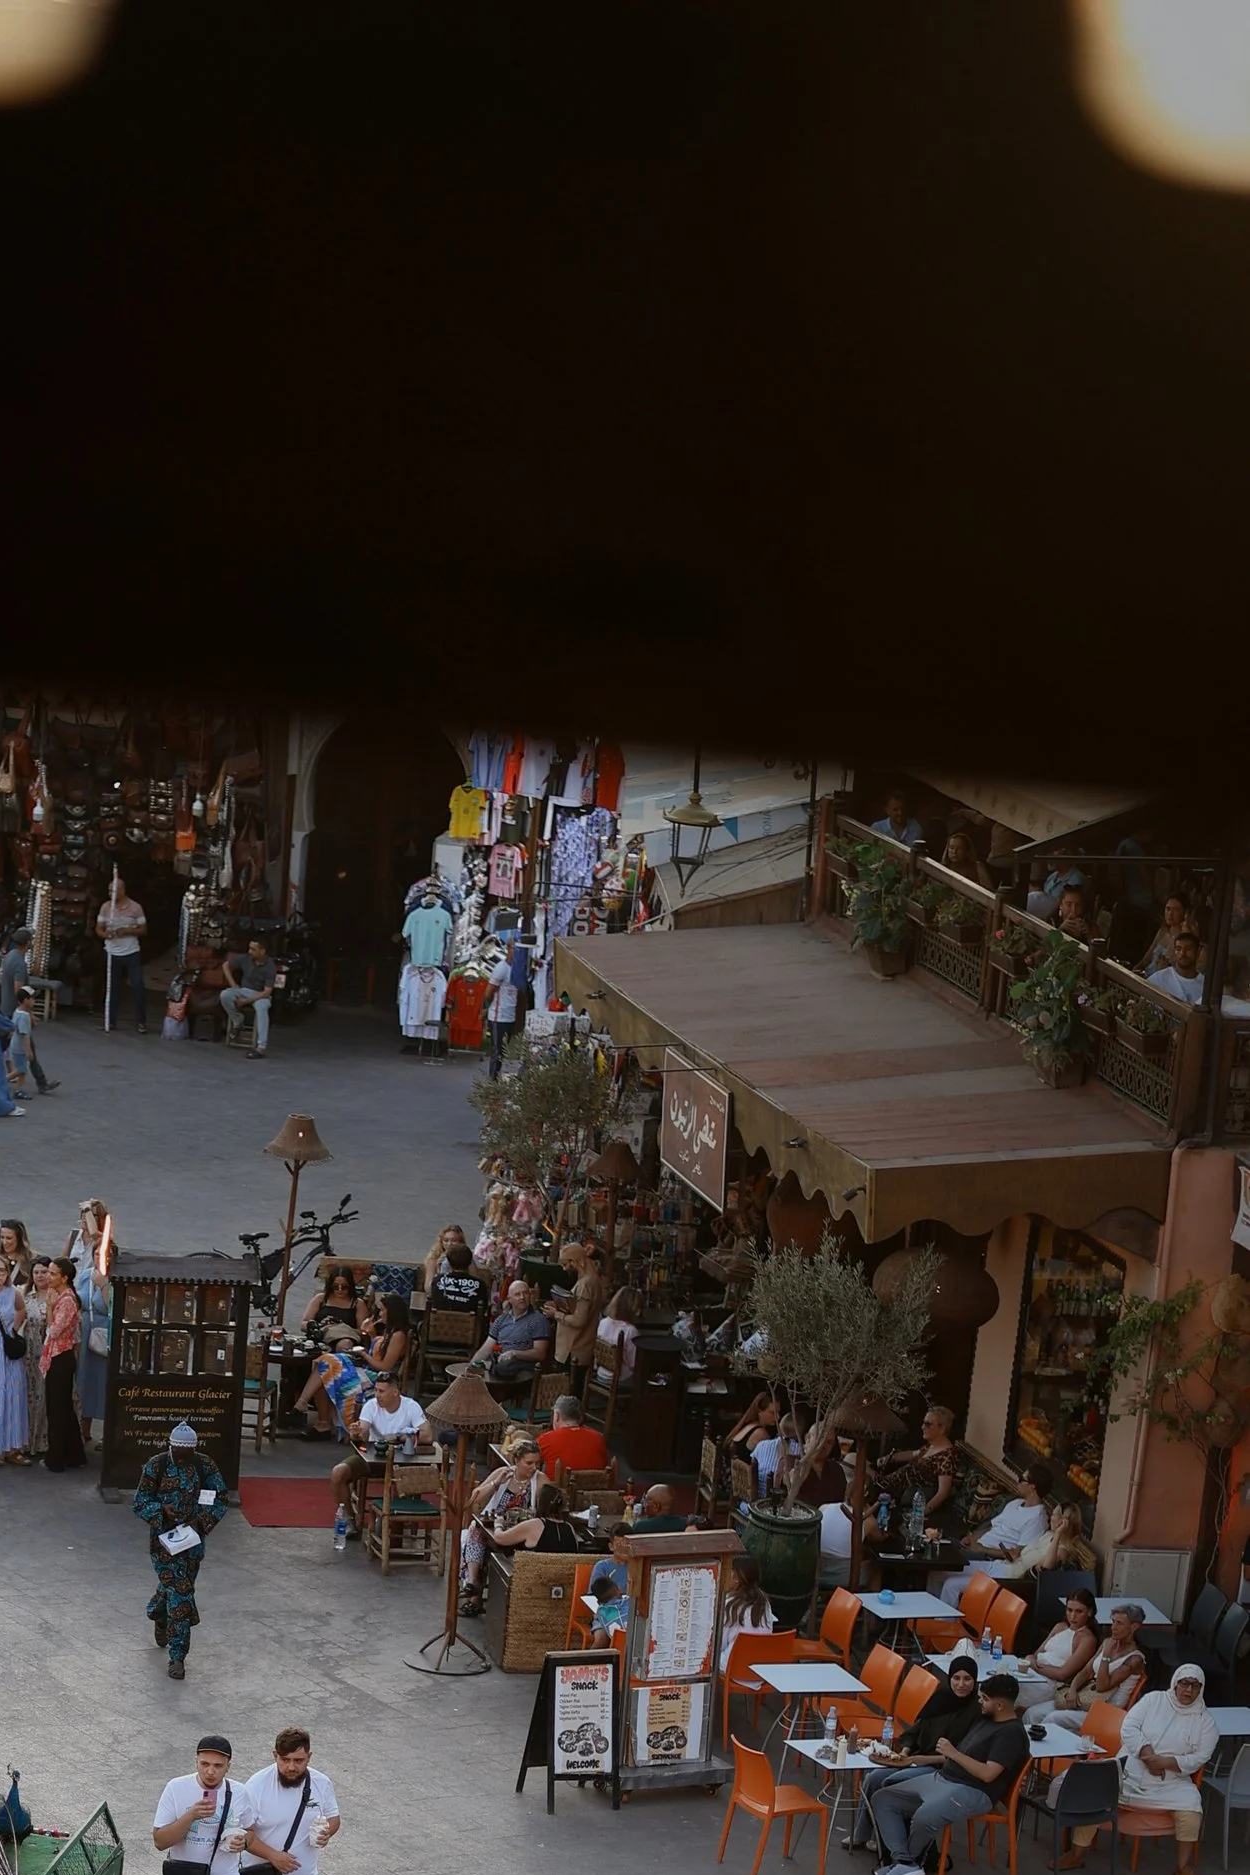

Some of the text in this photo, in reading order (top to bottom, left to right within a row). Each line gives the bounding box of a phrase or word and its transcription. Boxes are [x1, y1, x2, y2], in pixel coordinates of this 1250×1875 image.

[118, 1386, 232, 1400] Café Restaurant Glacier
[132, 1414, 167, 1422] Panoramic
[168, 1413, 189, 1422] heated
[571, 1680, 598, 1690] SNACK
[565, 1759, 600, 1770] WELCOME
